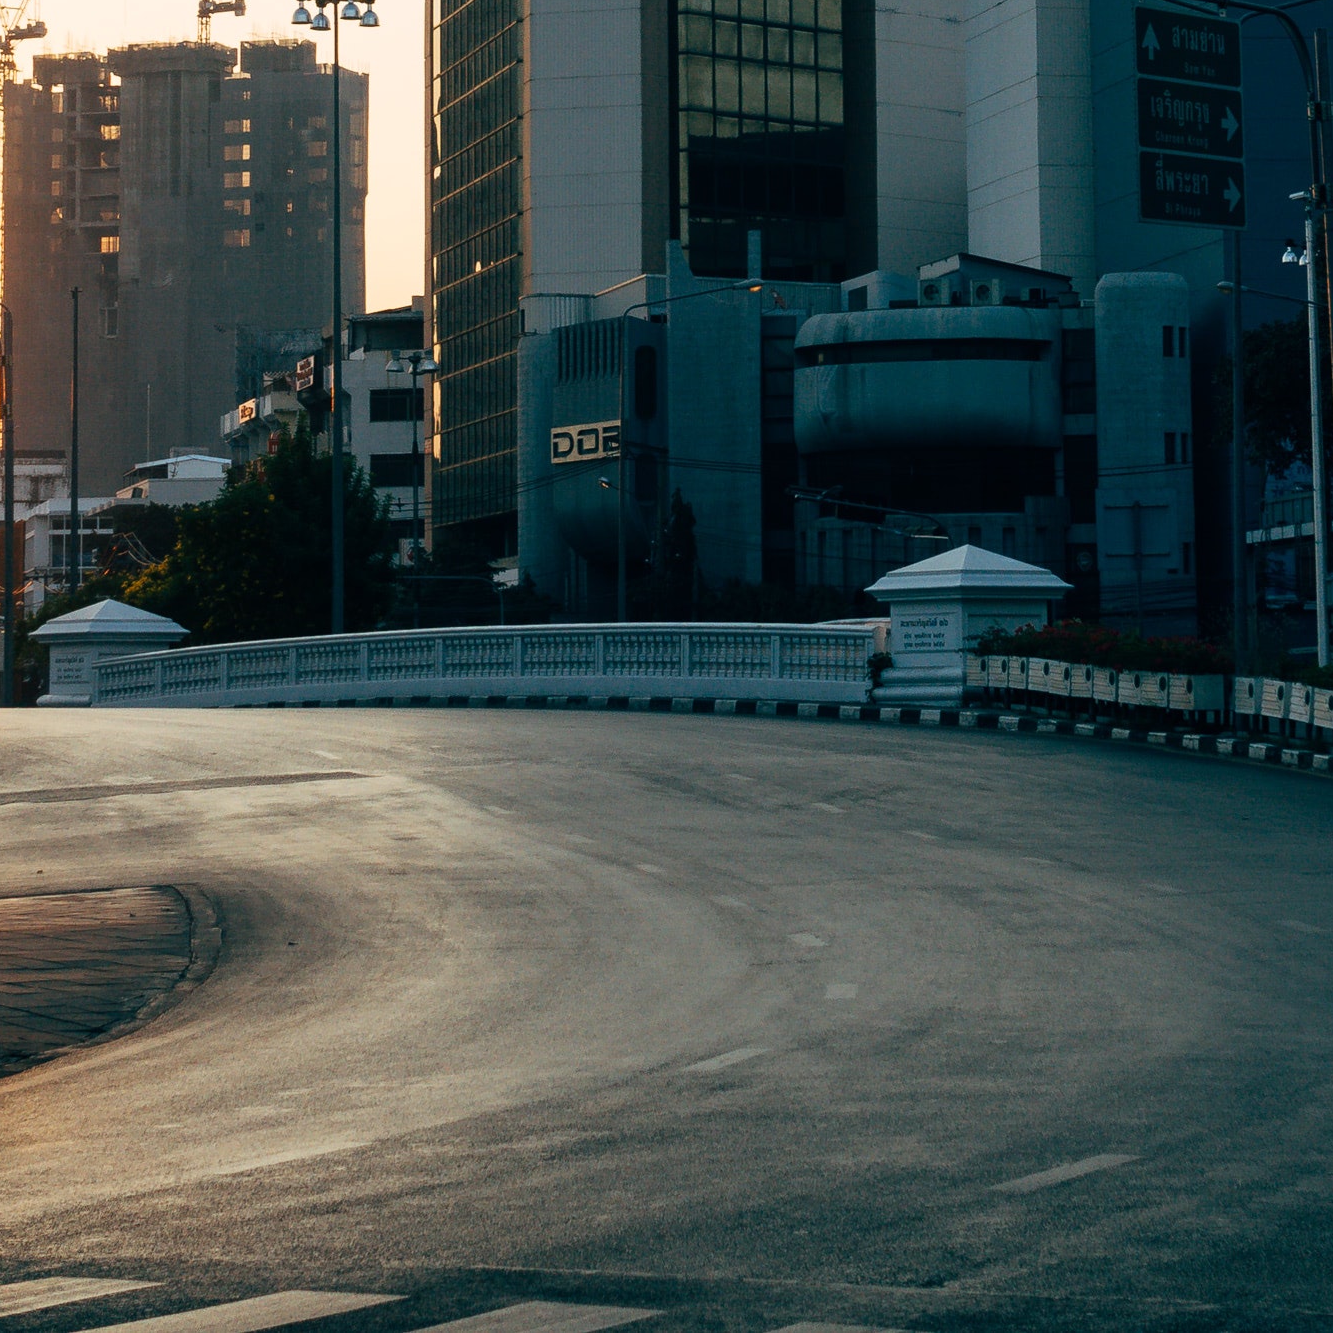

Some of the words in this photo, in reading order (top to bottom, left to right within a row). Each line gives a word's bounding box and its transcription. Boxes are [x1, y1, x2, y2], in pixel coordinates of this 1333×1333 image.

[1171, 24, 1226, 55] สามย่าน
[1150, 89, 1210, 132] เจริญกรุง
[1155, 153, 1209, 195] สี่พระยา
